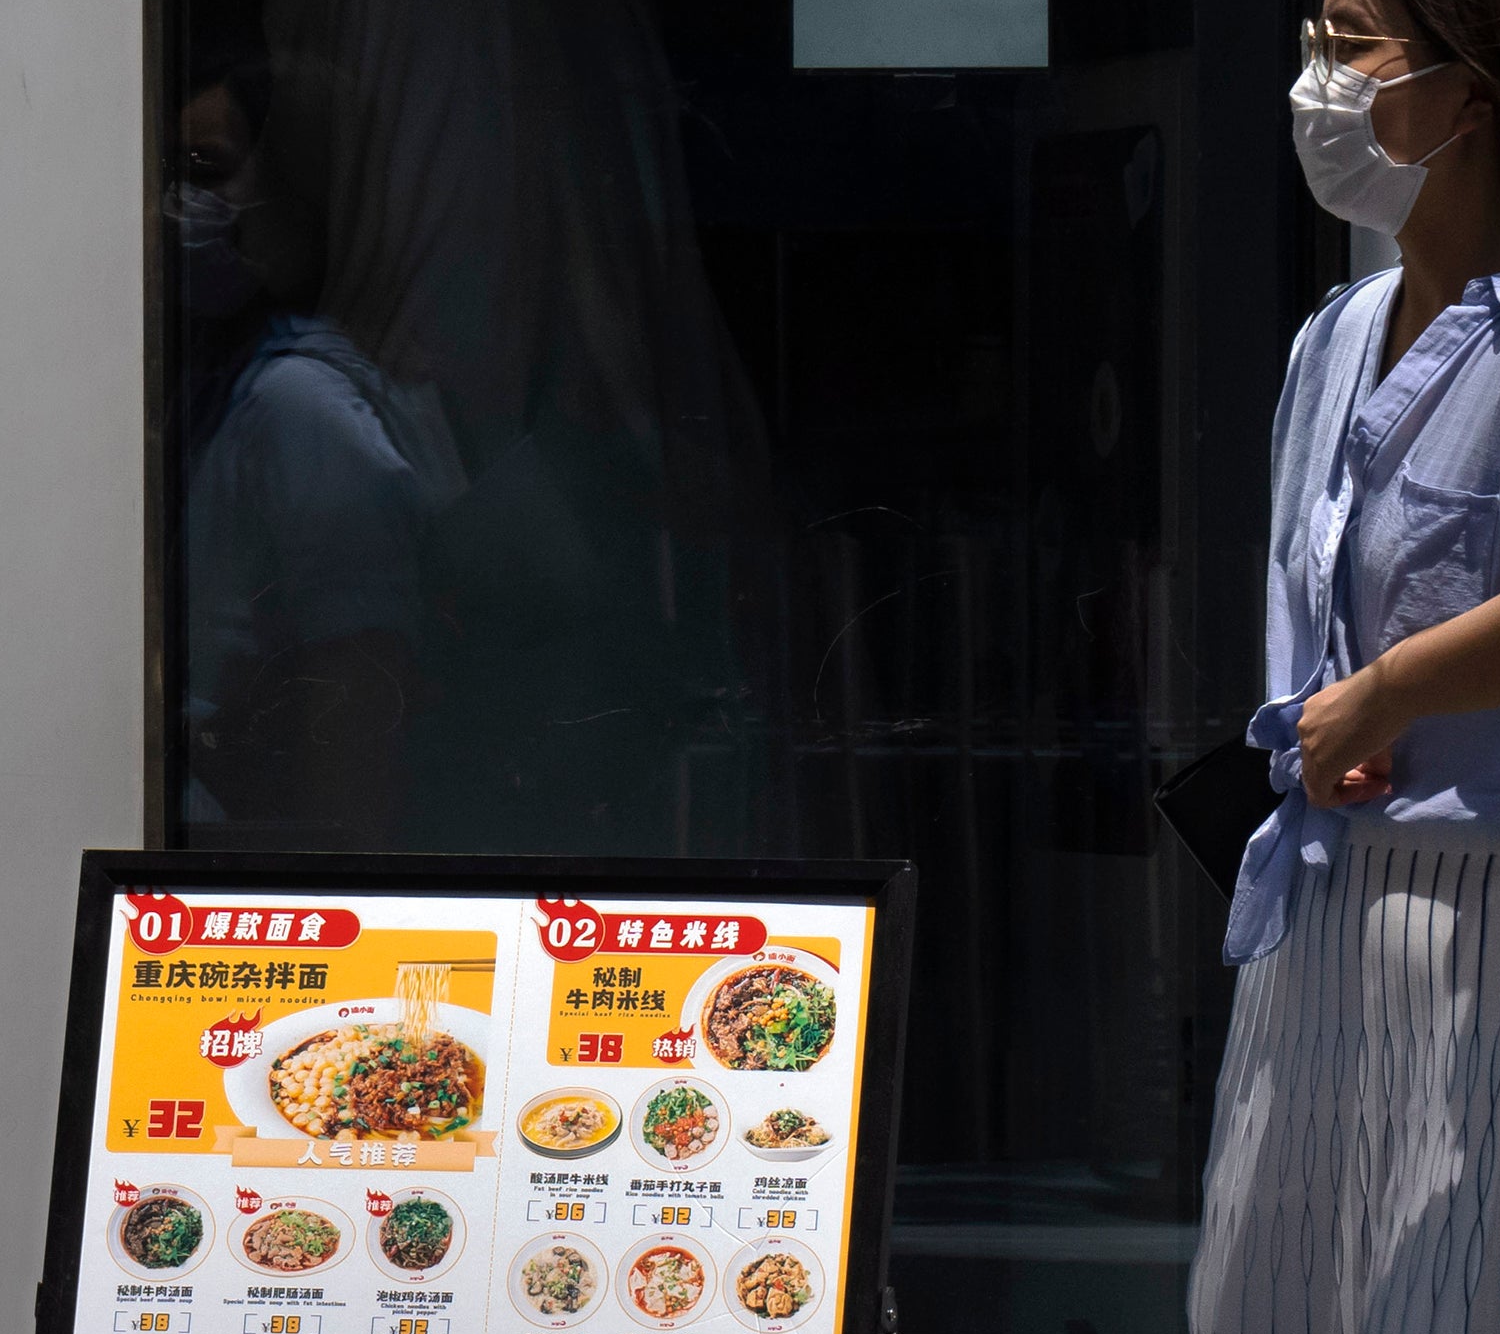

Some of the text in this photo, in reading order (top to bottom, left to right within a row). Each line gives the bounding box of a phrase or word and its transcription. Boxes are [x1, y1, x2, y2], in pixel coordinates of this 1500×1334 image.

[140, 912, 326, 942] 01 爆款面食
[549, 918, 740, 949] 02 特色米线
[132, 960, 329, 989] 重庆碗杂拌面
[593, 967, 641, 988] 秘制
[131, 994, 326, 1004] Chongqing bowl mixed noodles
[566, 990, 666, 1011] 牛肉米线
[200, 1028, 263, 1059] 招牌
[652, 1037, 696, 1058] 热销
[298, 1143, 417, 1166] 人气推荐
[530, 1173, 609, 1185] 酸汤肥牛米线
[754, 1177, 807, 1189] 鸡丝凉面
[630, 1180, 721, 1193] 番茄手打丸子面
[114, 1191, 139, 1202] 推荐
[237, 1198, 262, 1209] 推荐
[367, 1200, 392, 1211] 推荐
[117, 1285, 193, 1297] 秘制牛肉汤面
[248, 1287, 324, 1299] 秘制肥肠汤面
